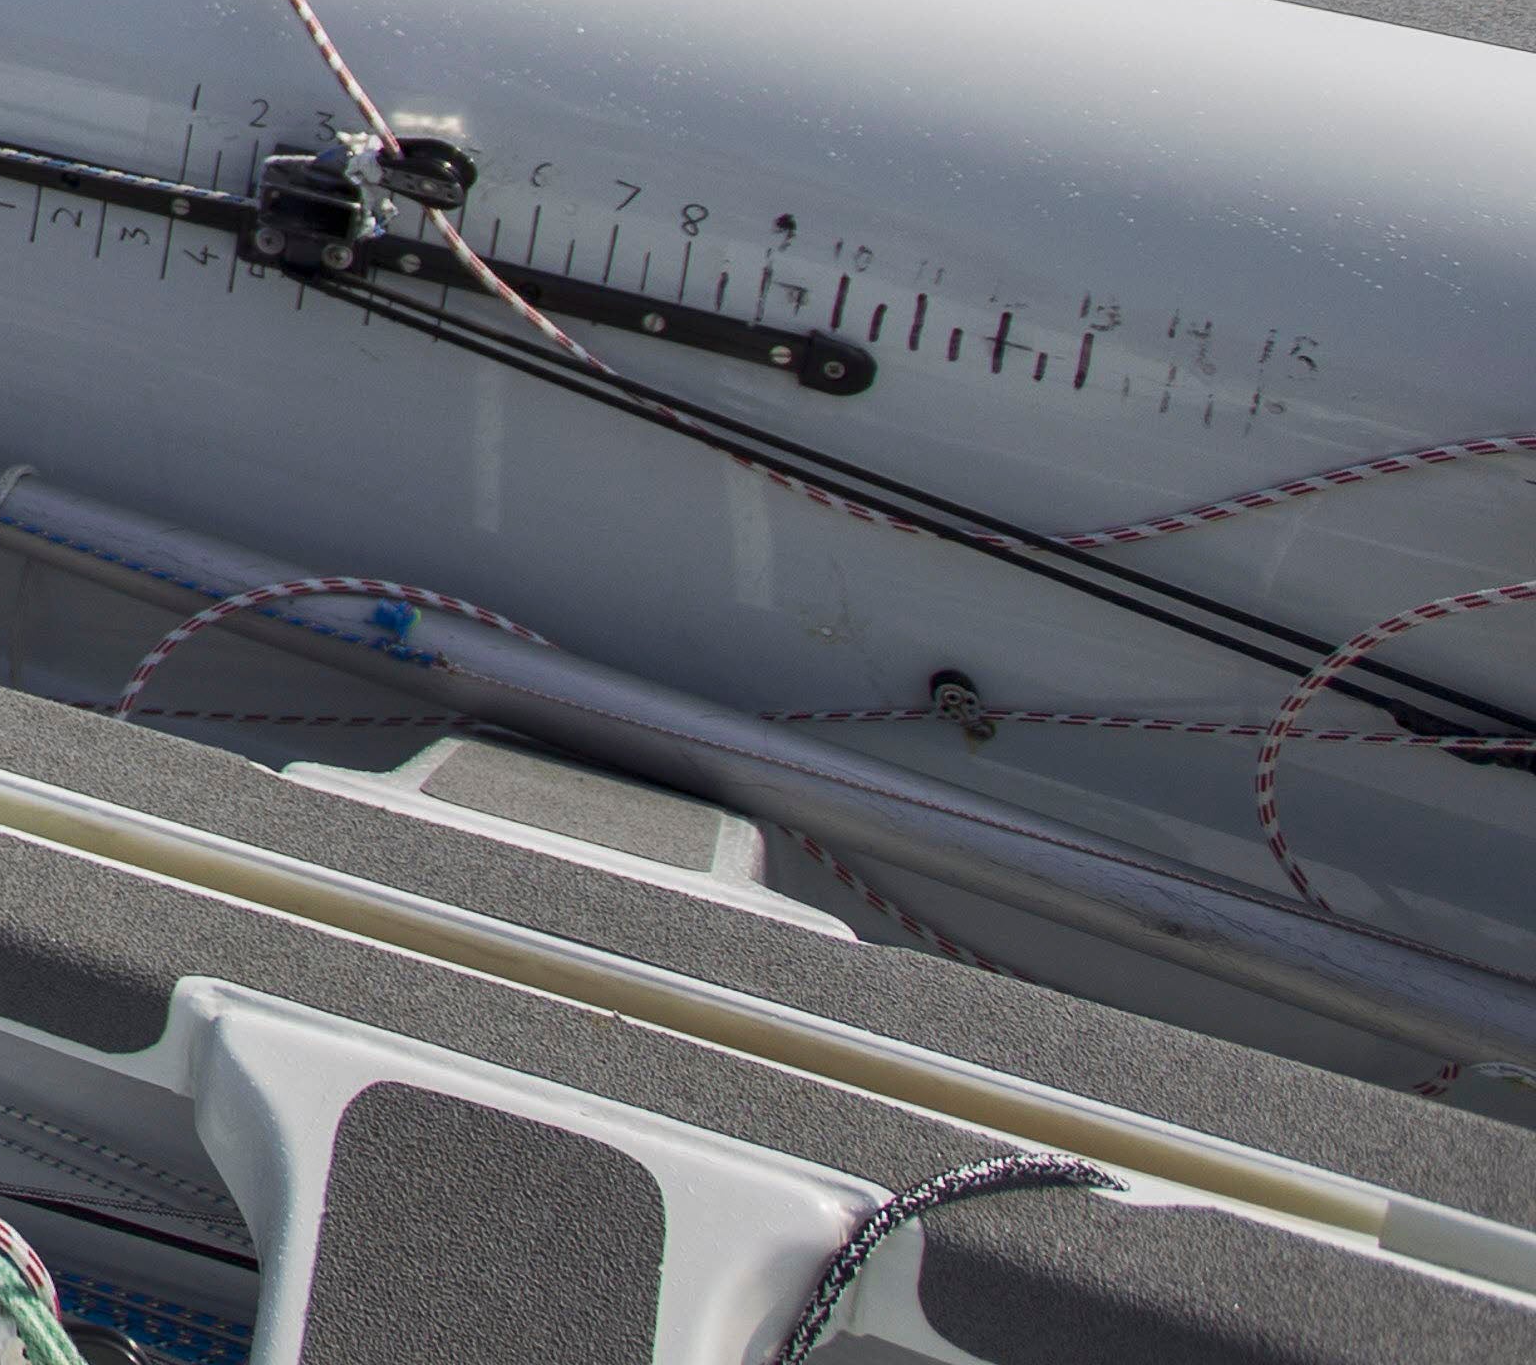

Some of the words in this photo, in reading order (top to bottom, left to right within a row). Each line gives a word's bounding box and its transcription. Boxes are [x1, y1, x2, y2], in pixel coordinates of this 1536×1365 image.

[249, 98, 270, 128] 2
[315, 110, 337, 142] 3
[615, 180, 642, 211] 7
[681, 203, 709, 237] 8
[120, 226, 151, 245] 3
[183, 244, 220, 265] 4
